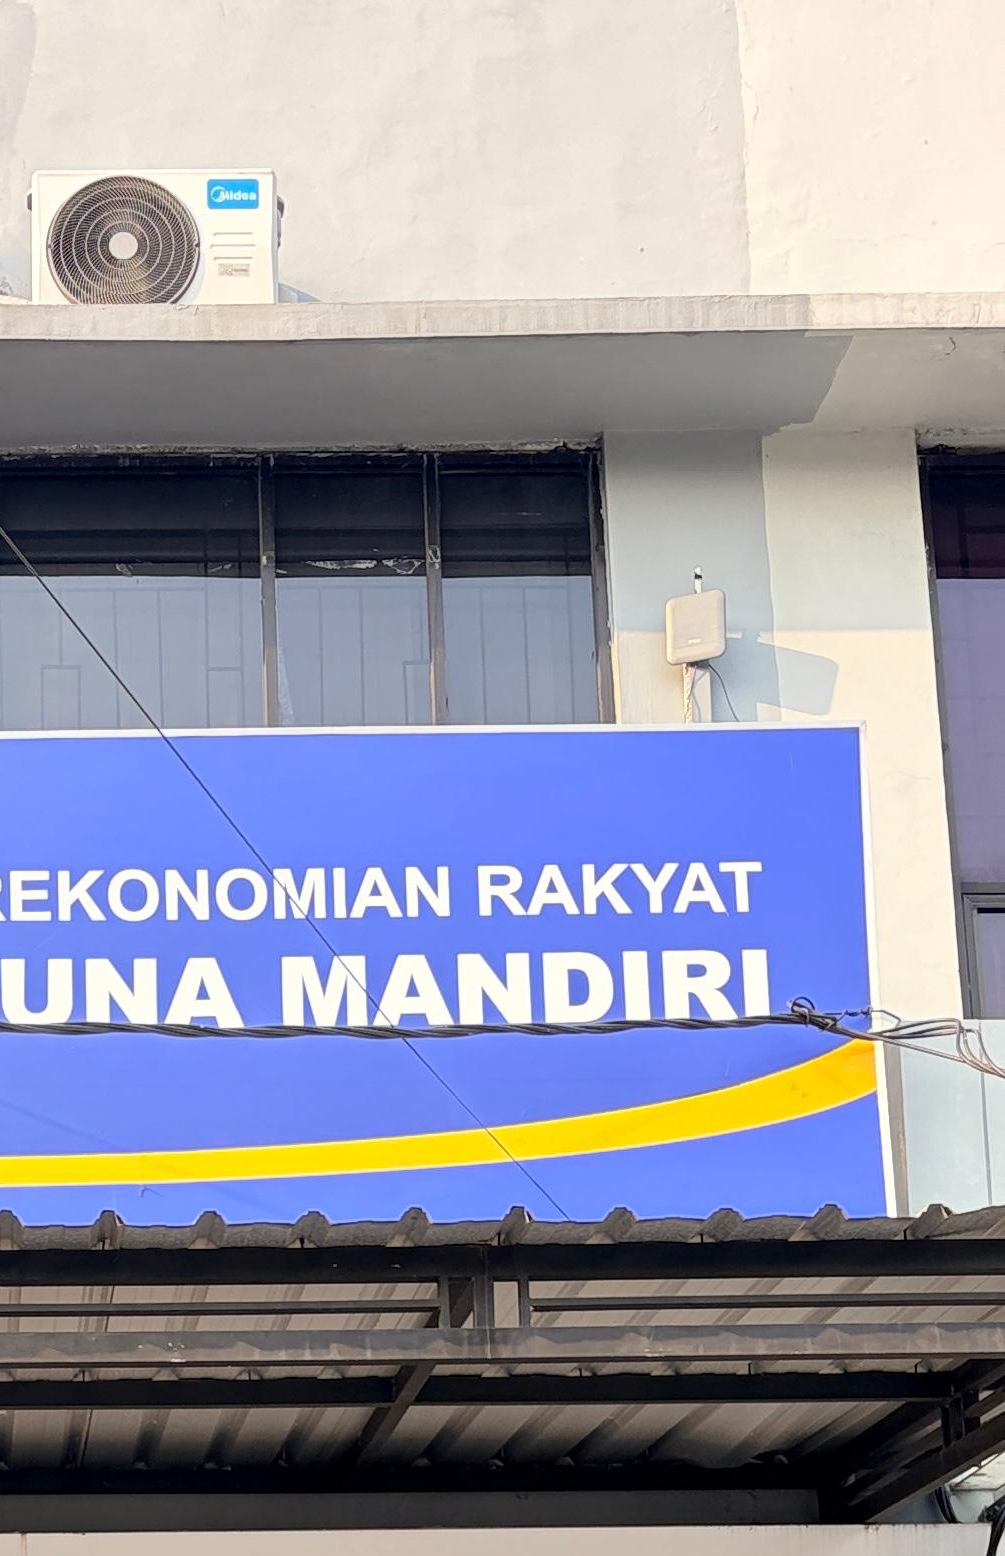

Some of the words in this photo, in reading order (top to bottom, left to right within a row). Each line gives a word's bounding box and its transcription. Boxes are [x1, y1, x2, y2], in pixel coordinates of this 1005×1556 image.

[218, 188, 257, 201] Midea
[477, 862, 762, 916] RAKYAT
[281, 949, 771, 1027] MANDIRI
